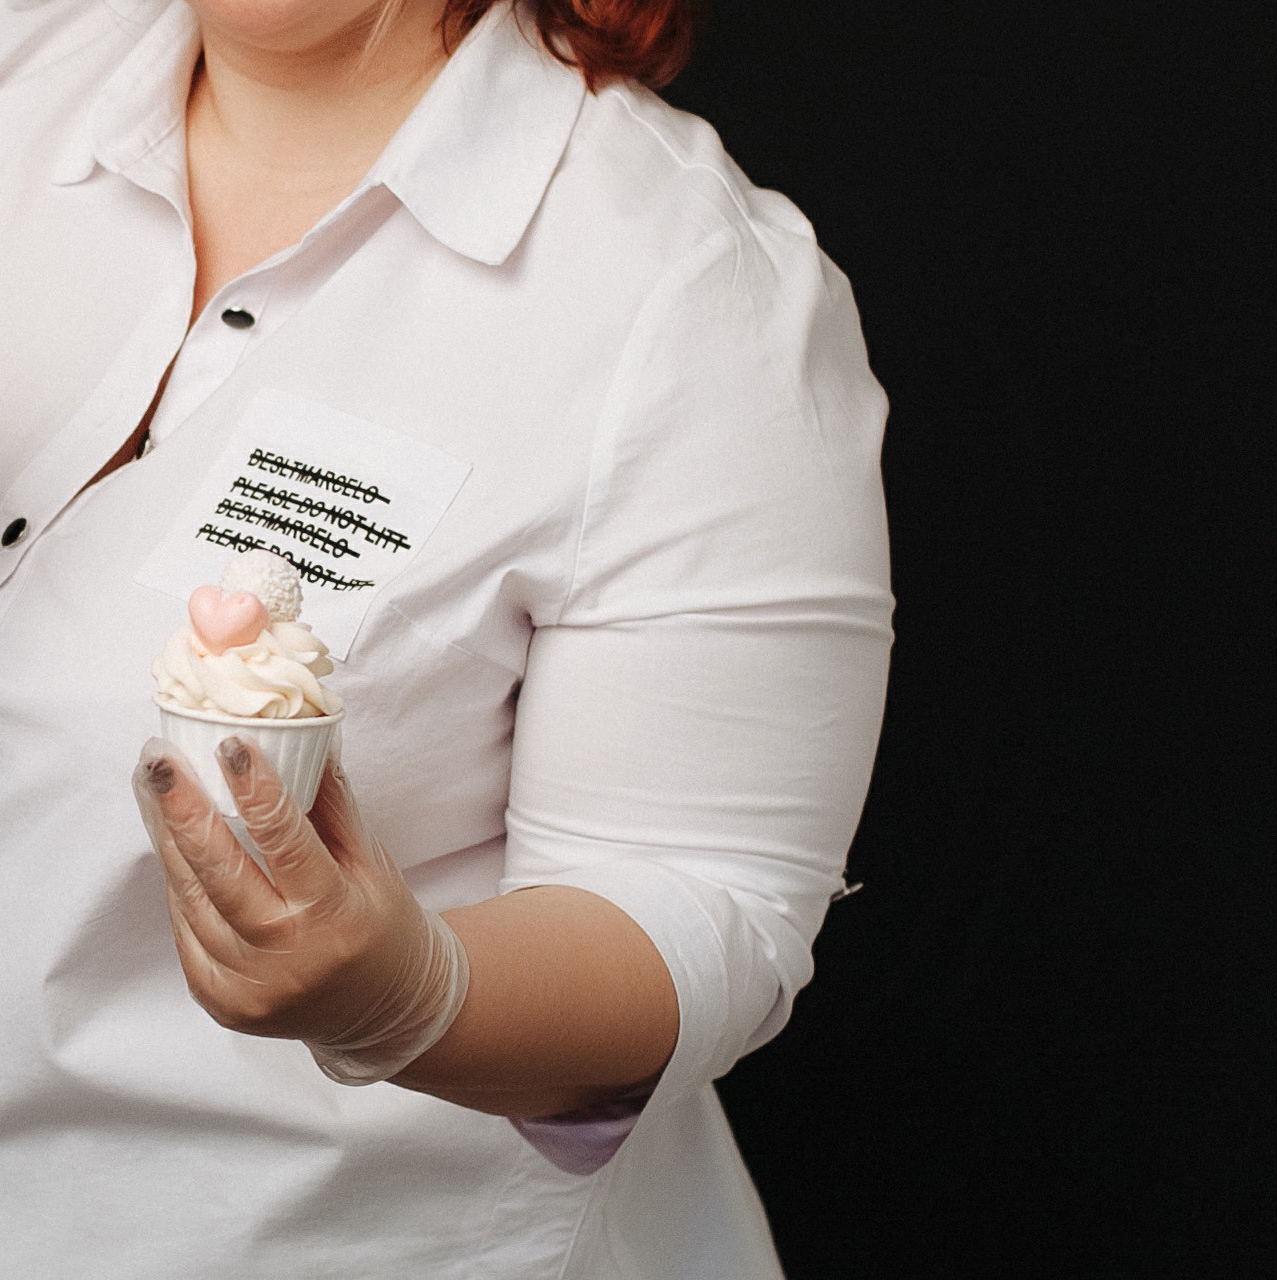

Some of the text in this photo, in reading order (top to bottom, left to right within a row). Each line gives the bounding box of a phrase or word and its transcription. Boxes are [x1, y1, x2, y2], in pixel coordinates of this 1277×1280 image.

[230, 476, 300, 510] PLEASE
[296, 497, 326, 518] DO
[323, 504, 368, 535] NOT
[297, 557, 337, 587] NOT
